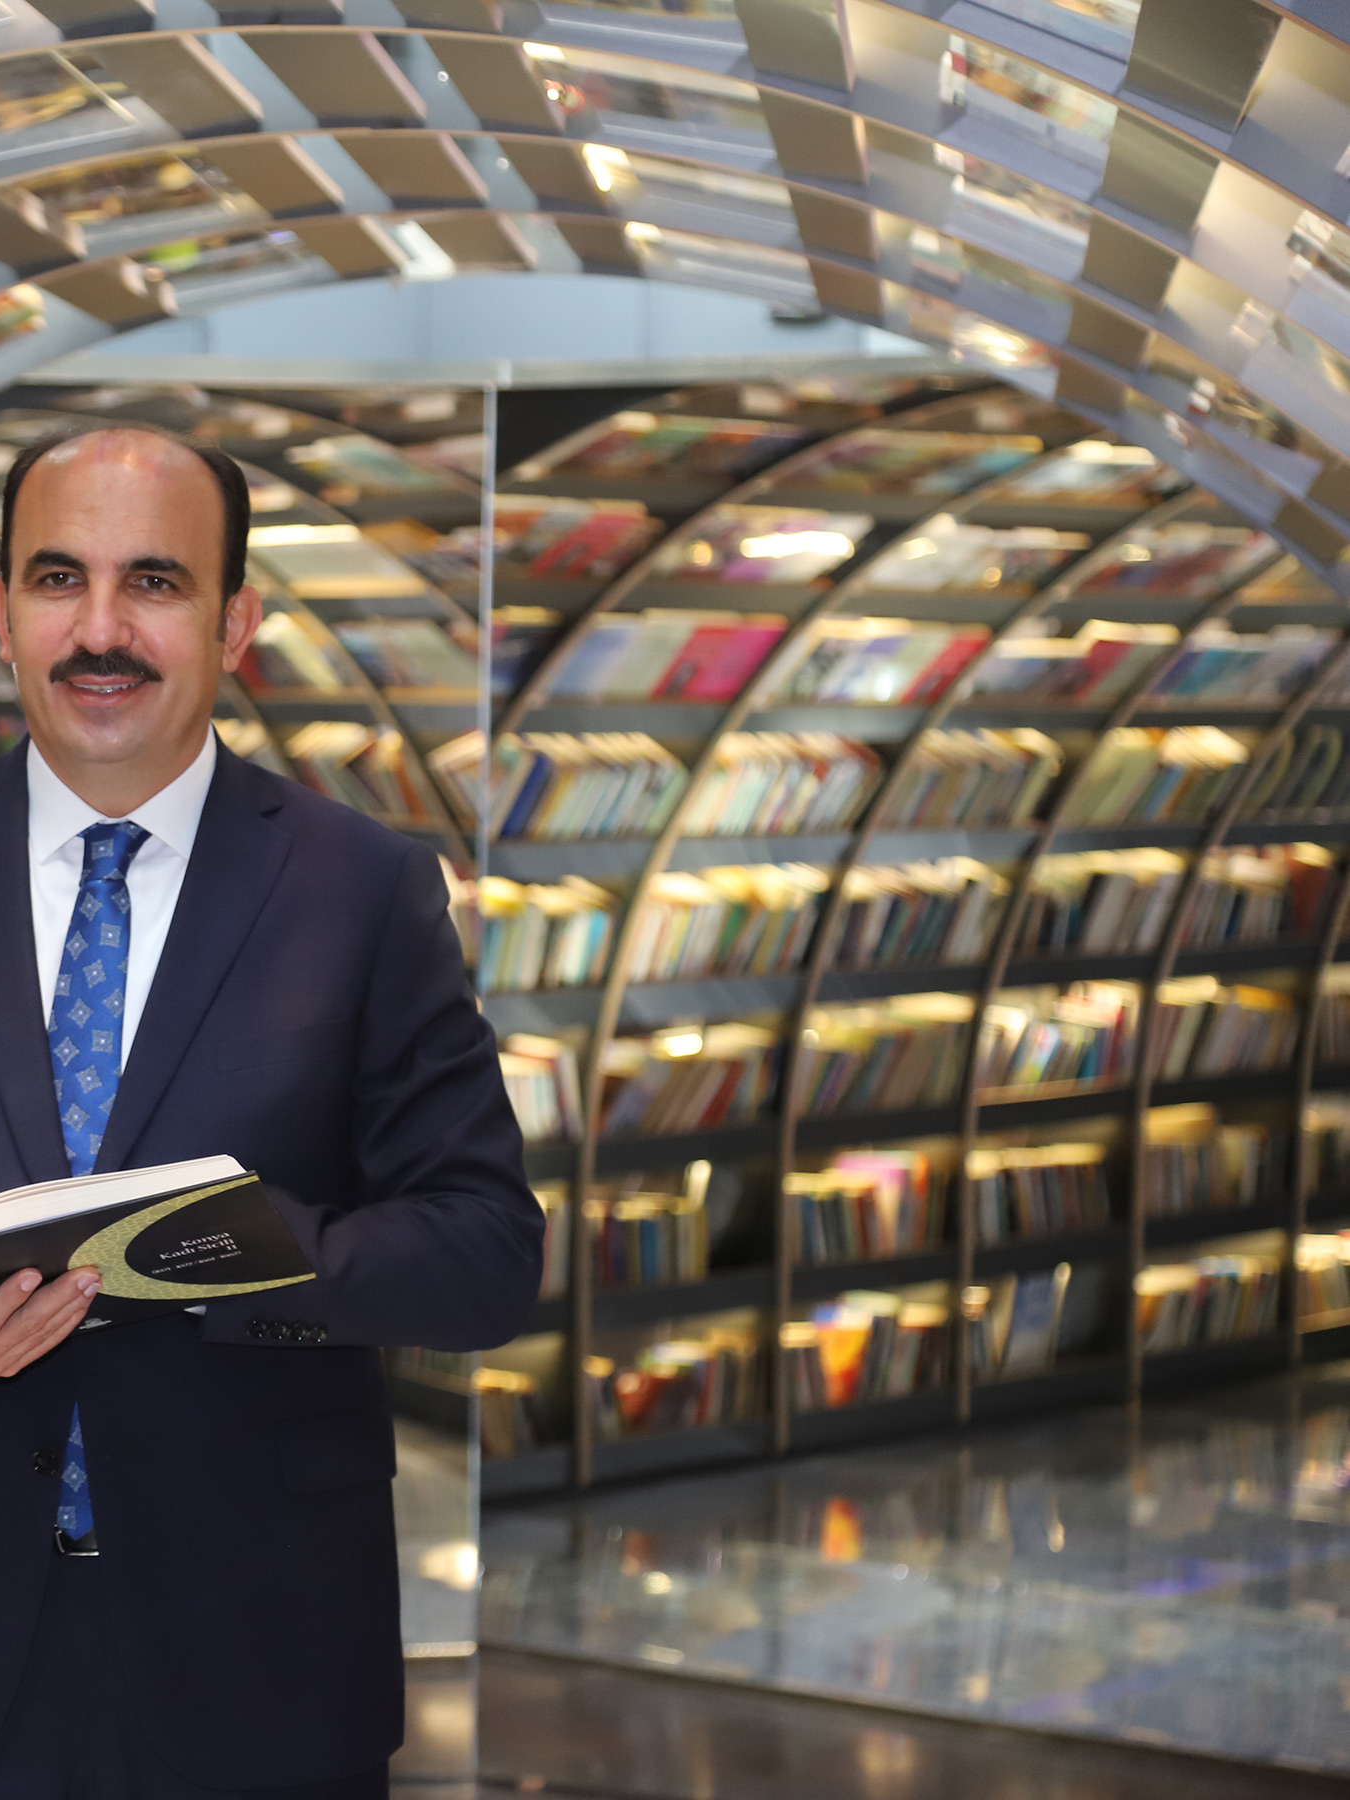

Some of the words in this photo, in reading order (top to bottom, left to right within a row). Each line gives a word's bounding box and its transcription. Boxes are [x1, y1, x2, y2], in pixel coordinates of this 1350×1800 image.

[159, 1247, 196, 1260] Kadı
[197, 1238, 235, 1252] Sicili
[180, 1232, 230, 1248] Konya
